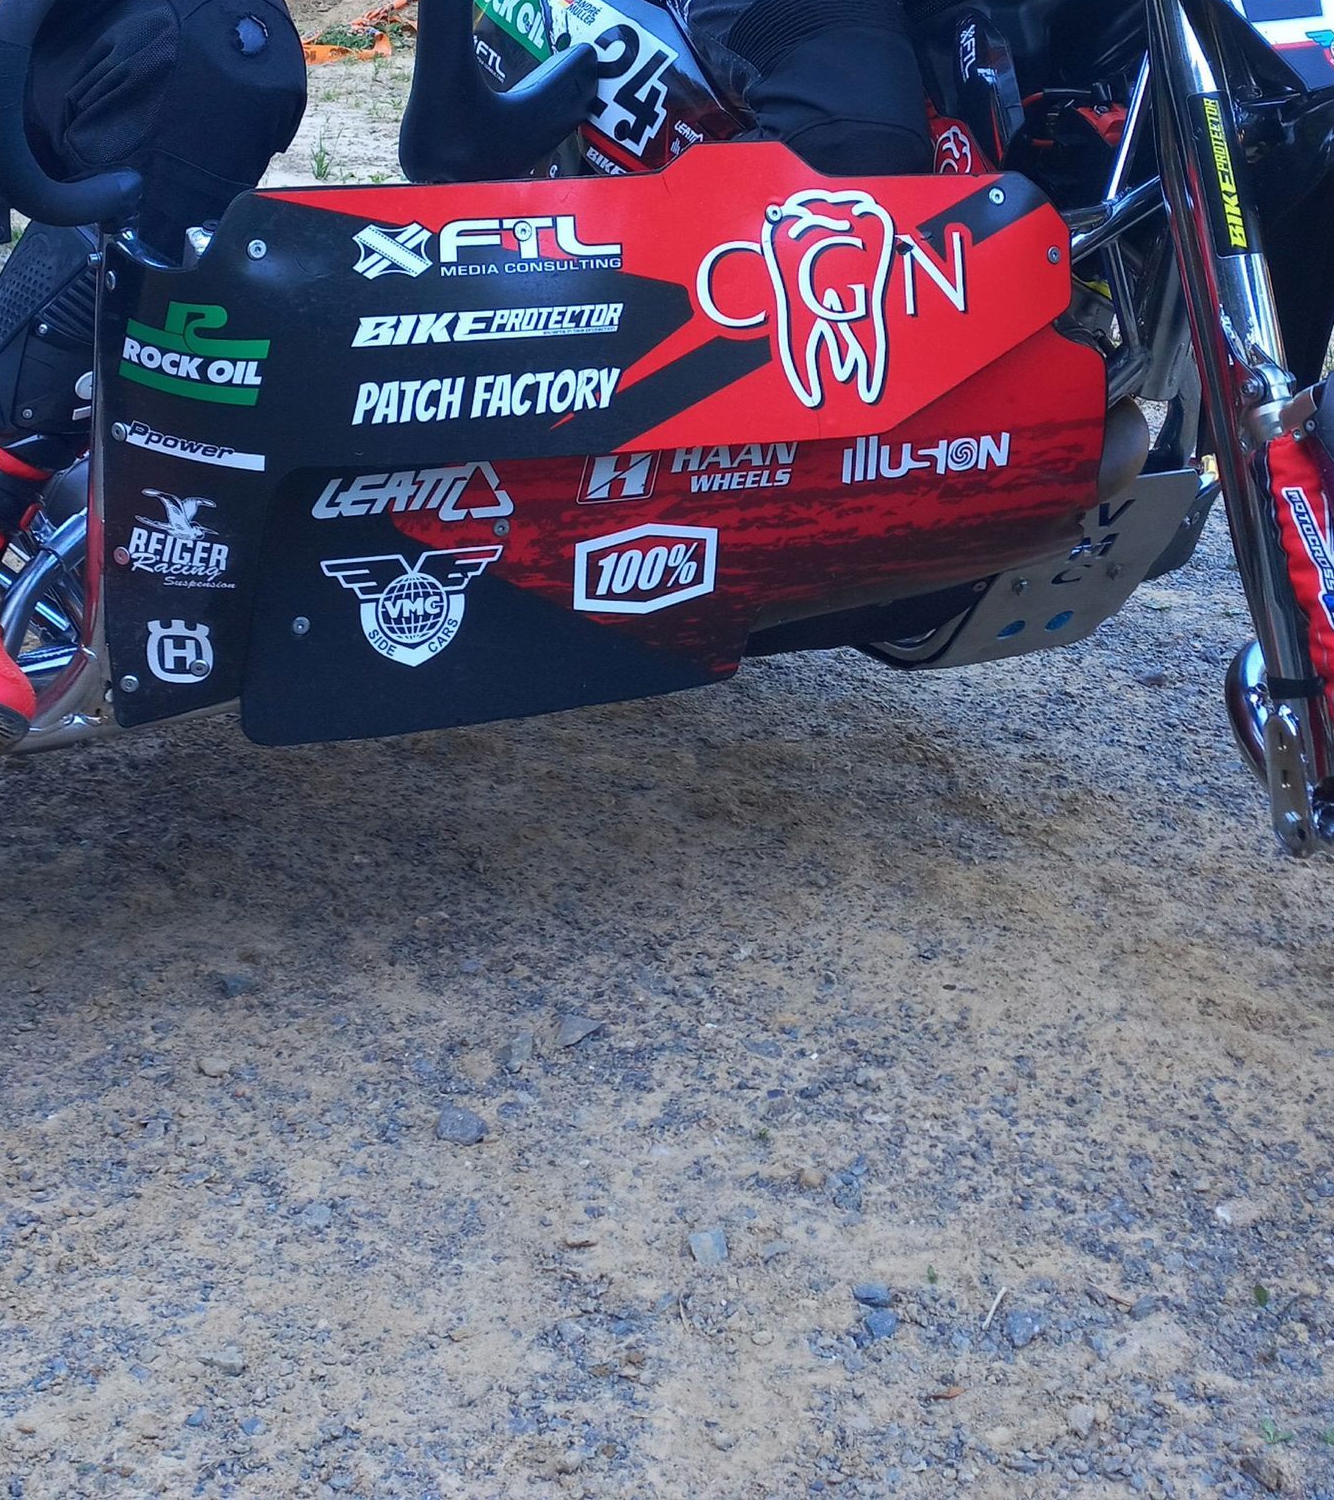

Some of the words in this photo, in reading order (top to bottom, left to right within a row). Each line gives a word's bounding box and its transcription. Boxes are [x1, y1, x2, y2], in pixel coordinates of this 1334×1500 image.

[516, 2, 546, 50] OIL
[475, 42, 506, 80] FTL
[588, 23, 669, 146] 24
[439, 213, 624, 264] FTL
[440, 262, 499, 277] MEDIA
[503, 256, 623, 275] CONSULTING
[696, 230, 967, 329] CGN
[122, 337, 202, 381] ROCK
[206, 356, 263, 387] OIL
[352, 376, 470, 426] PATCH
[470, 367, 622, 421] FACTORY
[128, 419, 235, 461] Ppower
[670, 442, 800, 474] HAAN
[689, 467, 793, 494] WHEELS
[128, 526, 230, 571] REIGER
[131, 552, 222, 582] Racing
[595, 541, 699, 596] 100%
[162, 576, 237, 590] Suspension
[381, 595, 445, 618] VMC
[367, 626, 397, 658] SIDE
[428, 616, 460, 655] CARS
